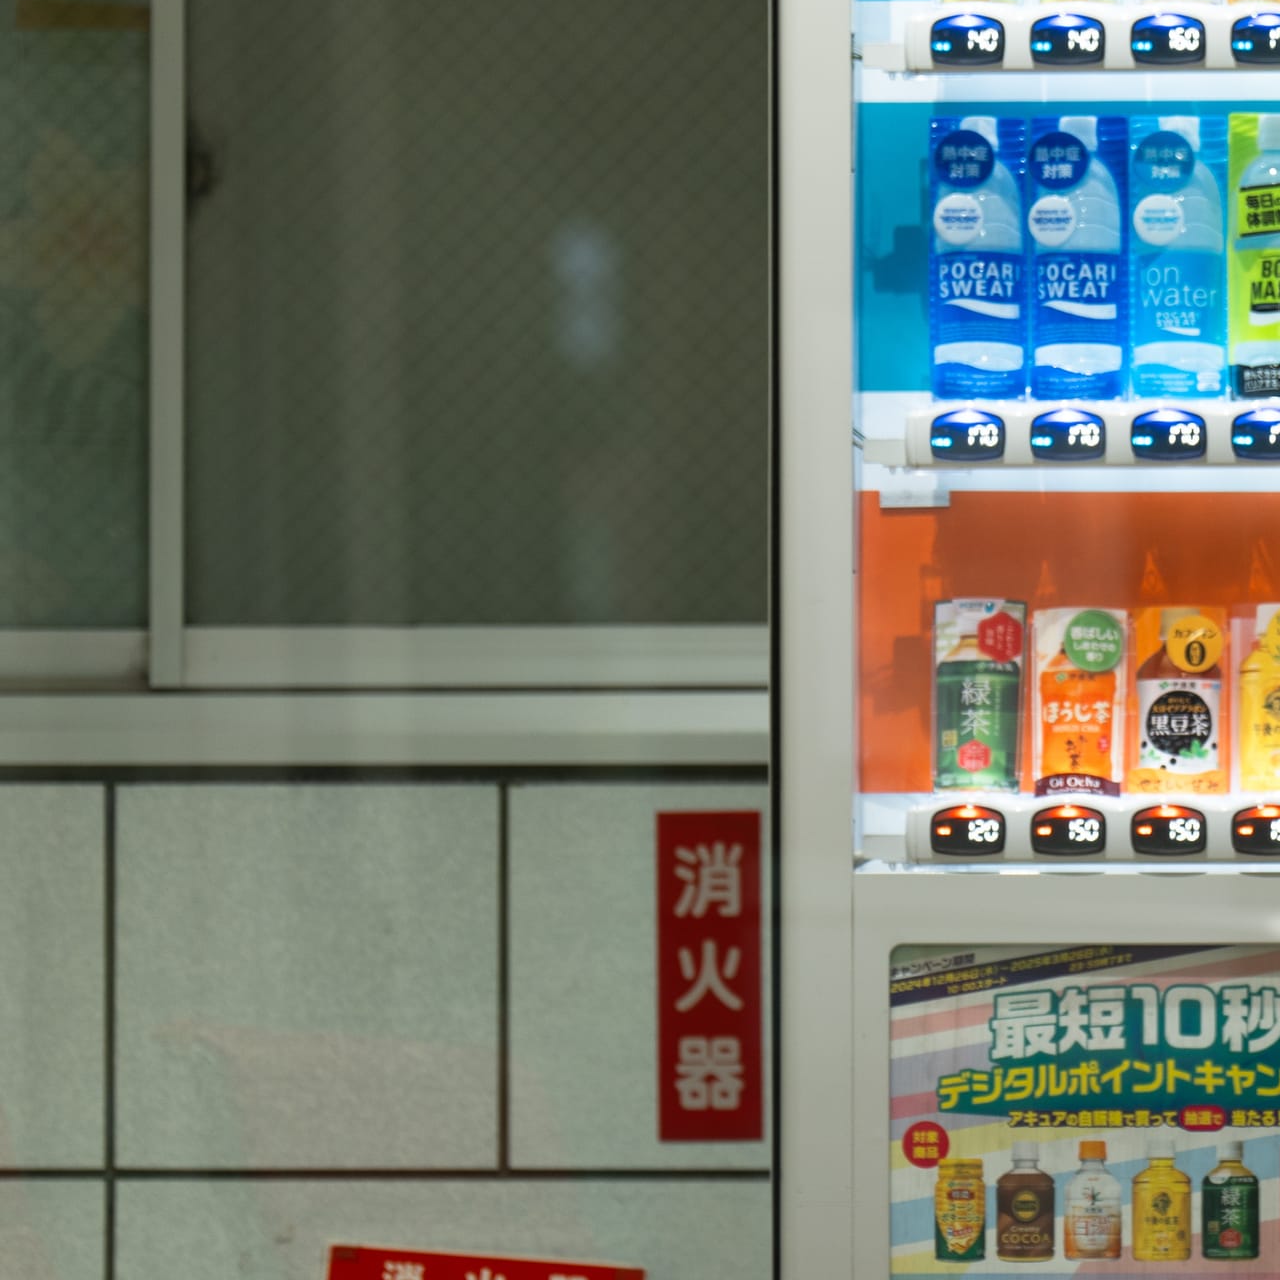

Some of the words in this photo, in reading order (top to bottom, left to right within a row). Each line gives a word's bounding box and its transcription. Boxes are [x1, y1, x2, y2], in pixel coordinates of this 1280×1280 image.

[939, 262, 1020, 281] POCARI
[938, 280, 1015, 299] SWEAT
[1038, 282, 1110, 299] SWEAT
[1141, 285, 1218, 308] water
[967, 422, 999, 448] 170
[1067, 422, 1100, 448] 170
[1168, 422, 1201, 447] 170
[960, 679, 991, 737] 緑茶
[1043, 701, 1110, 723] ほうじ茶
[1149, 715, 1210, 738] 黒豆茶
[1049, 777, 1064, 788] Oi
[1066, 777, 1101, 788] Ocha
[968, 818, 999, 842] 120
[1068, 818, 1100, 842] 150
[1169, 818, 1200, 842] 150
[674, 841, 745, 1111] 消火器
[1001, 1232, 1051, 1245] COCOA
